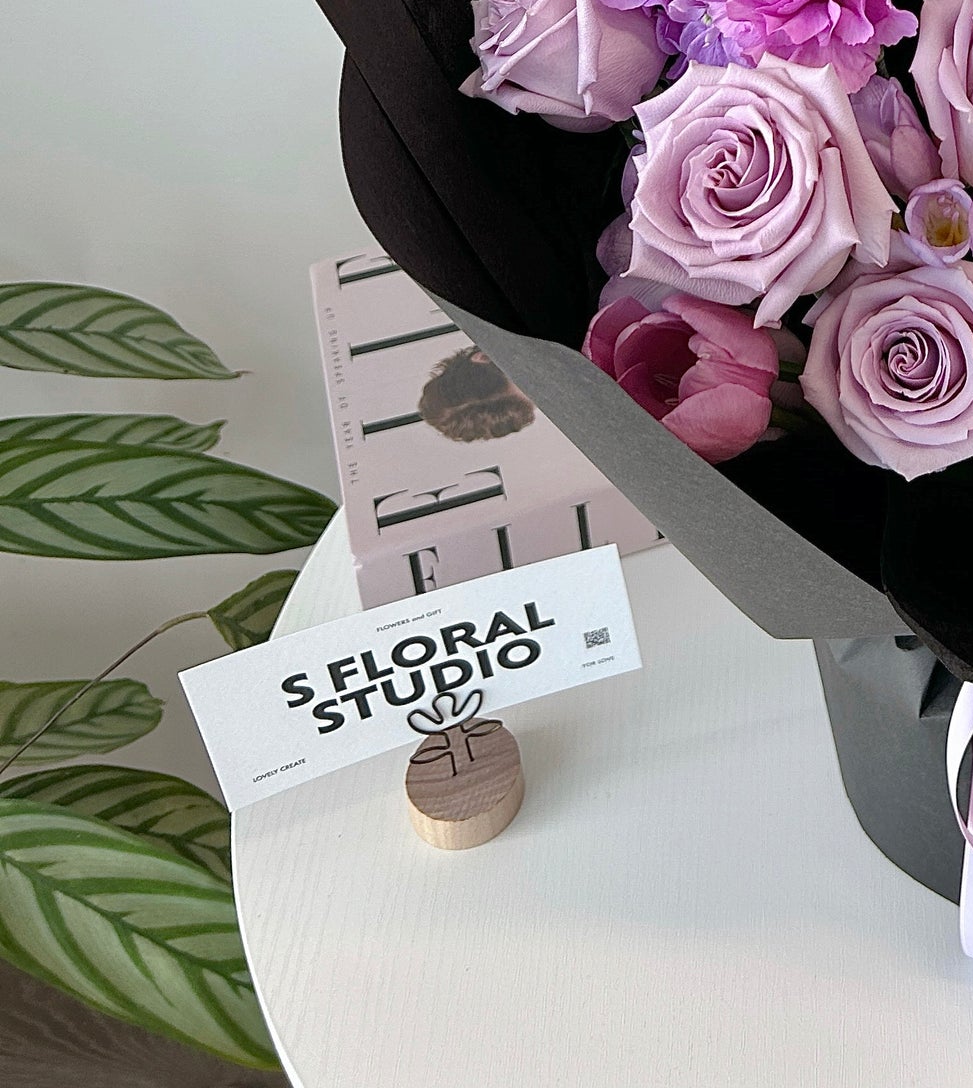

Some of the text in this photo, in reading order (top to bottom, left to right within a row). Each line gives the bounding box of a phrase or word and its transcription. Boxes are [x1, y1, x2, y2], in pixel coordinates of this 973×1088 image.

[376, 618, 410, 632] FLOWERS
[412, 614, 425, 622] and
[282, 601, 556, 709] S FLORAL
[312, 638, 541, 735] STUDIO
[252, 758, 306, 783] LOVELY CREATE
